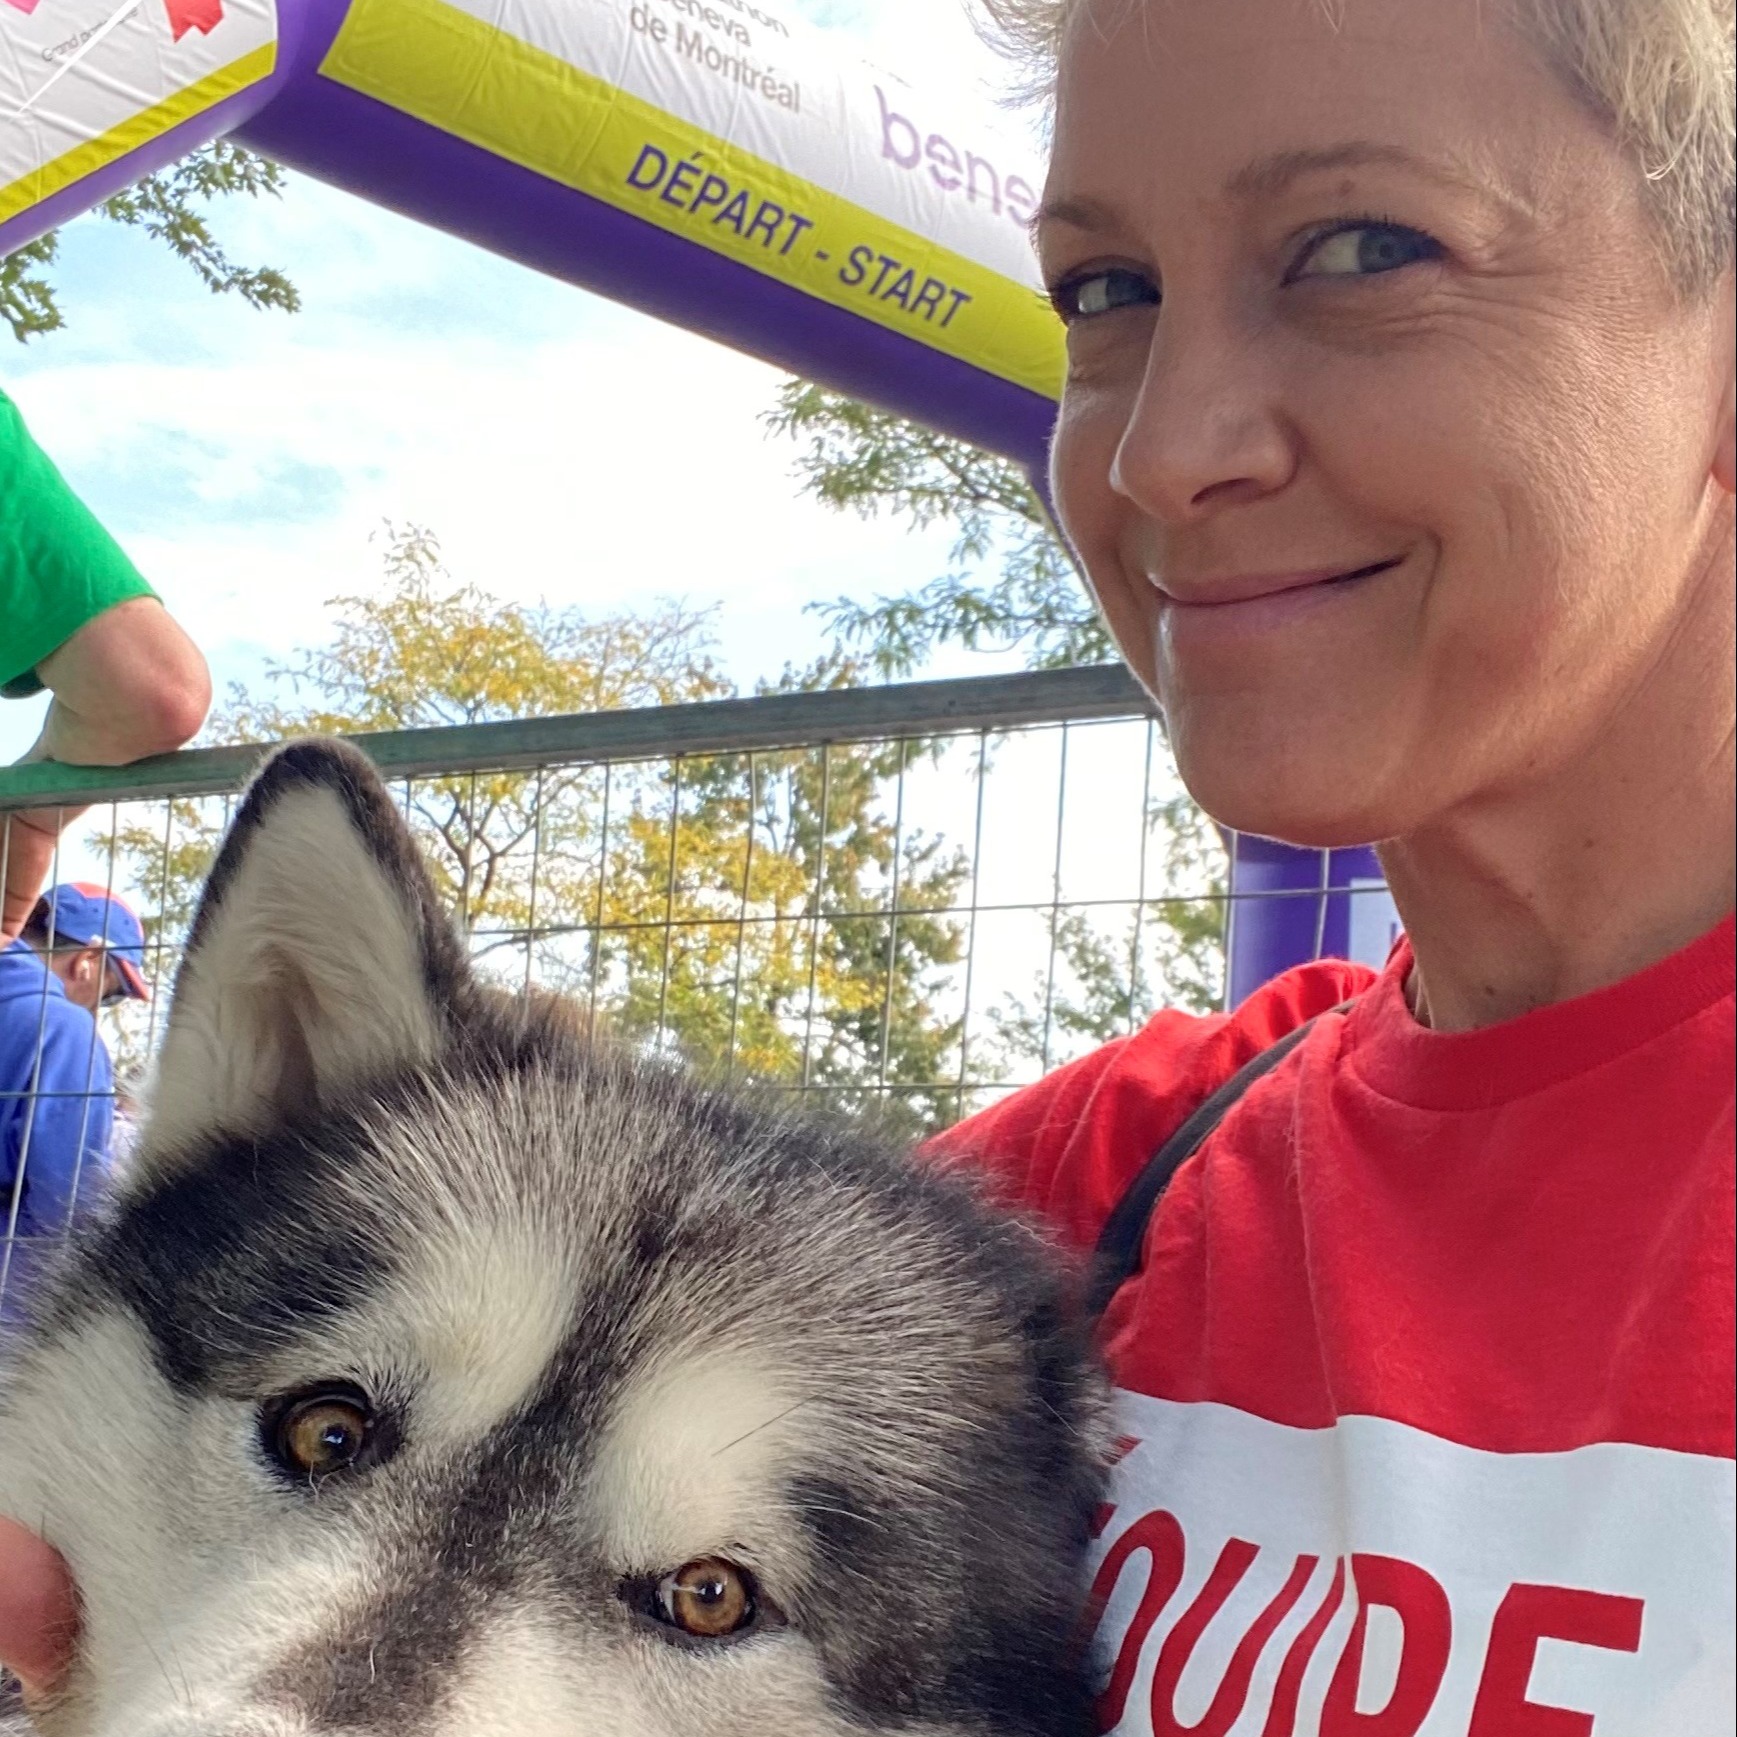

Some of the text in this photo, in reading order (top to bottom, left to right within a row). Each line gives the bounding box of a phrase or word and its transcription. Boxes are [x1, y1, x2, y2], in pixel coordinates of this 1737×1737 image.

[629, 5, 800, 114] de Montréal
[625, 143, 814, 257] DÉPART
[838, 244, 972, 328] START
